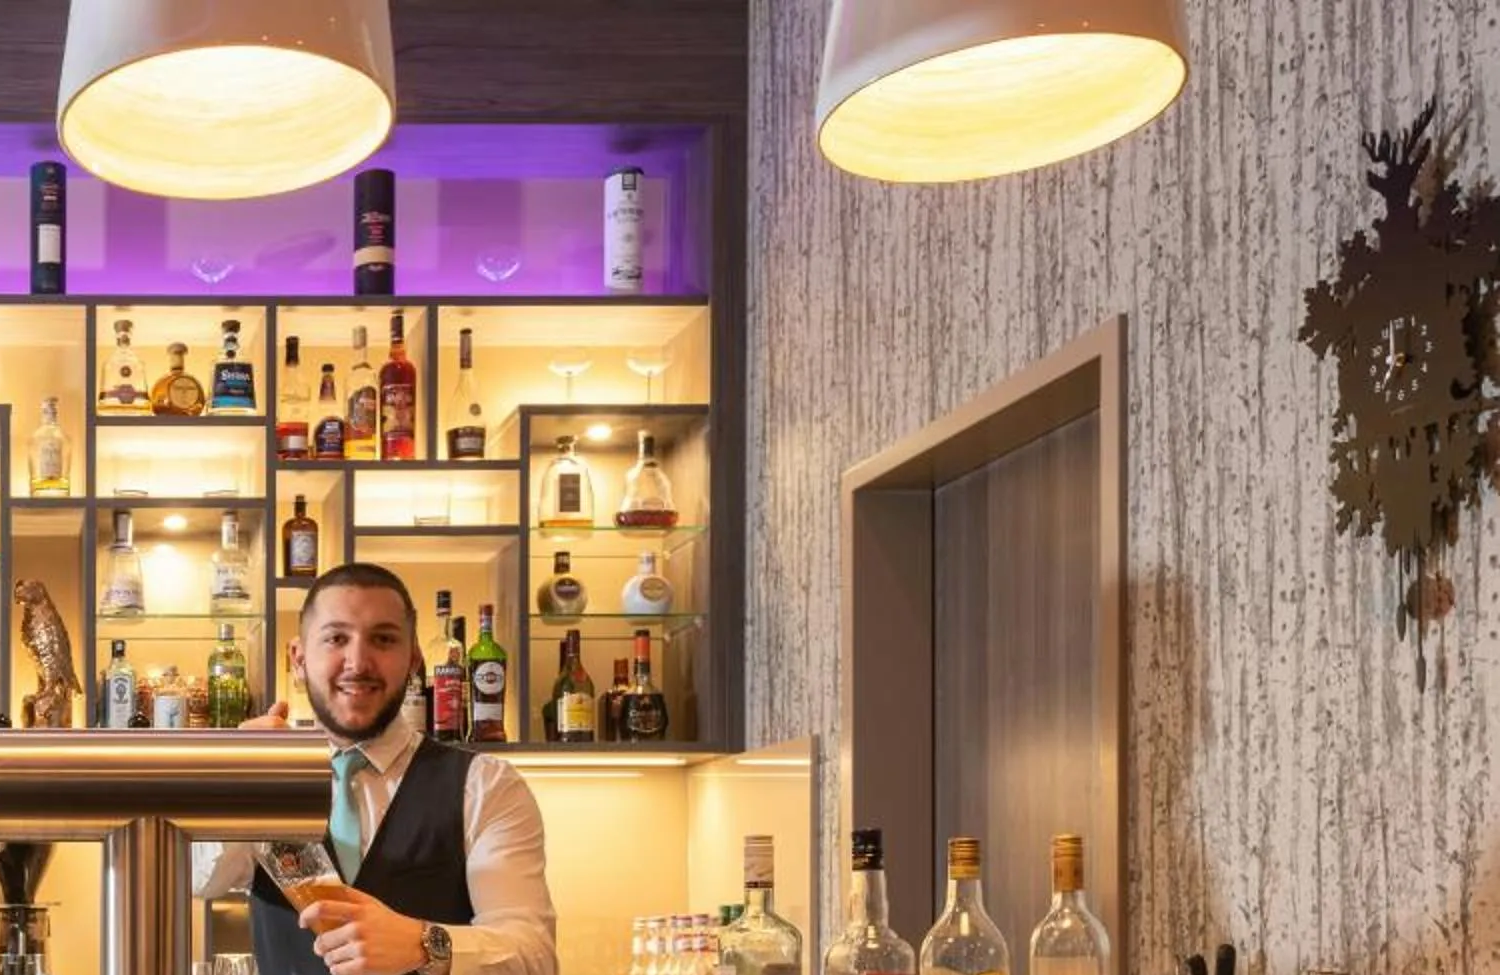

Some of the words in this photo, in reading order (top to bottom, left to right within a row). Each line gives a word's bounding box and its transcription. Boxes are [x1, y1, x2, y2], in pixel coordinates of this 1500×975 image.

[1411, 315, 1415, 327] 1
[1421, 324, 1427, 336] 2
[1425, 341, 1433, 353] 3
[1369, 365, 1377, 376] 9
[1420, 361, 1427, 373] 4
[1374, 381, 1381, 393] 8
[1412, 379, 1418, 391] 5
[1385, 389, 1391, 403] 7
[1397, 389, 1405, 401] 6
